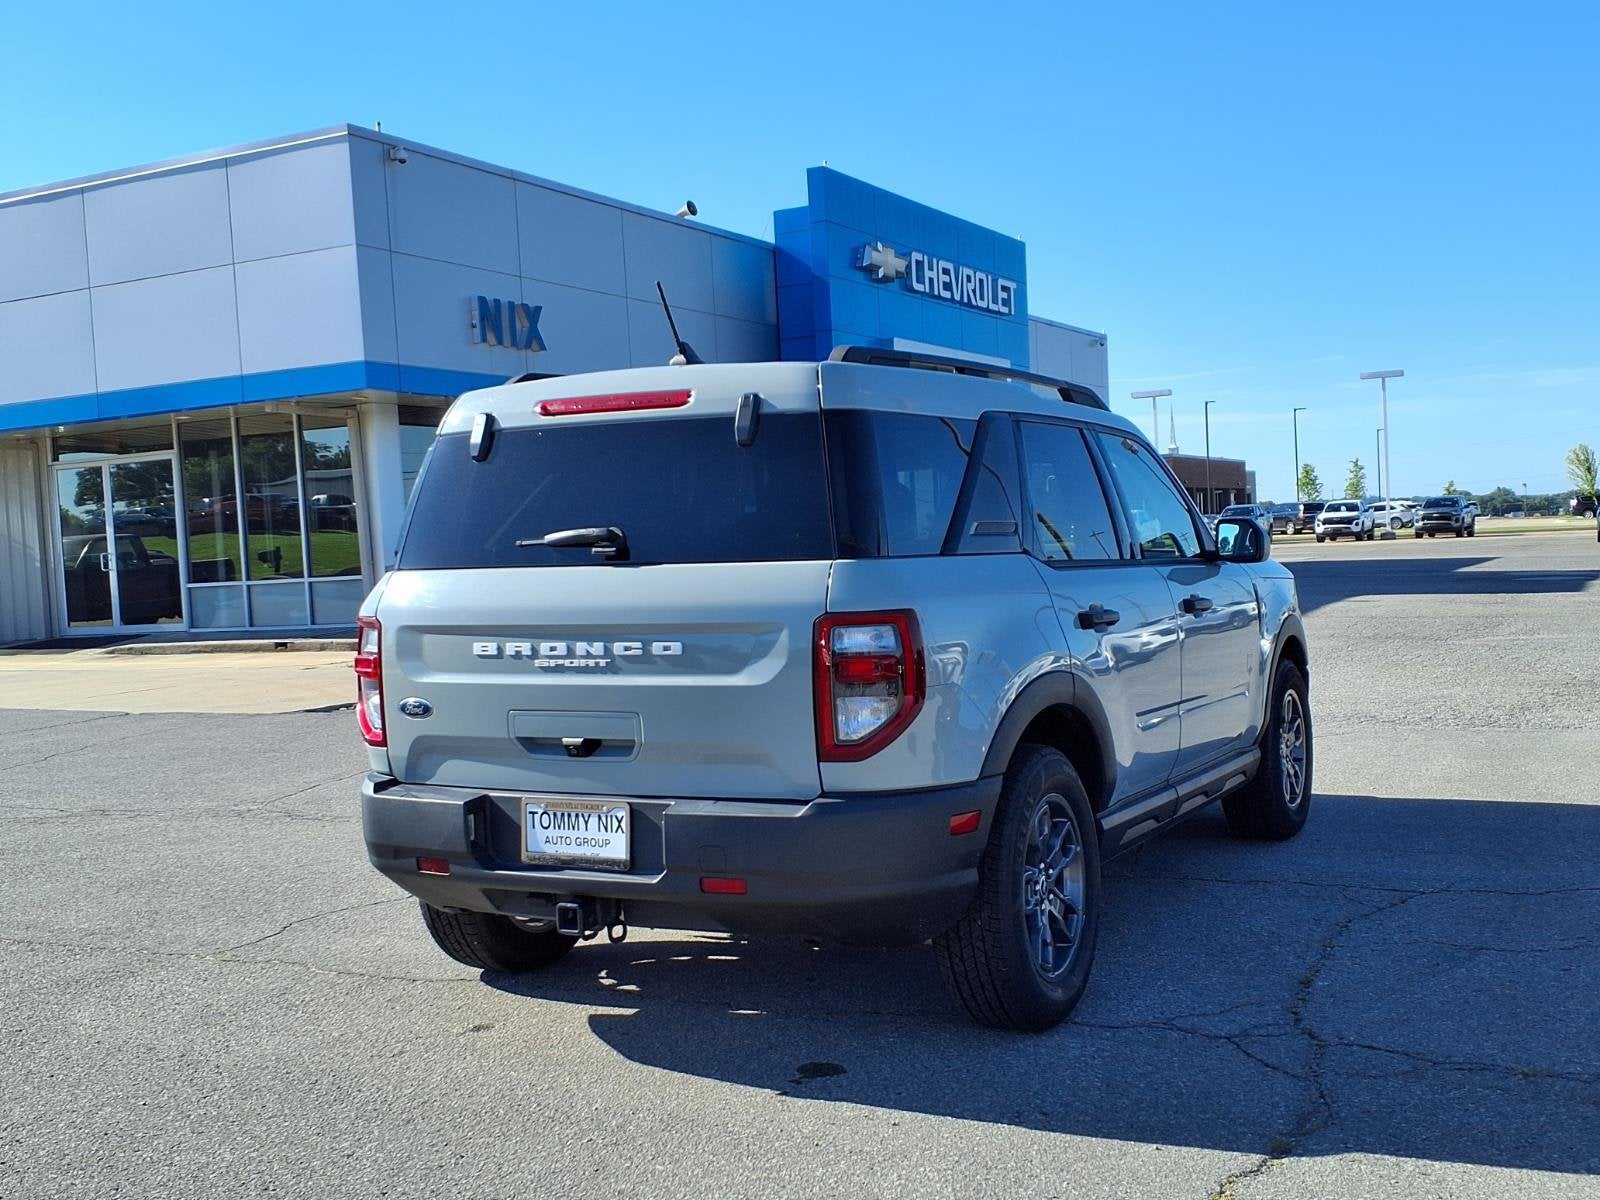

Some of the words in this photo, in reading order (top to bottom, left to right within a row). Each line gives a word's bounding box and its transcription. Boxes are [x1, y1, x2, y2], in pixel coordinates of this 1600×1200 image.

[911, 251, 1017, 315] CHEVROLET
[473, 295, 548, 352] NIX
[472, 641, 684, 656] BRONCO
[534, 659, 611, 667] SPORT
[528, 811, 591, 832] TOMMY
[598, 814, 625, 834] NIX
[544, 835, 572, 846] AUTO
[575, 837, 611, 848] GROUP
